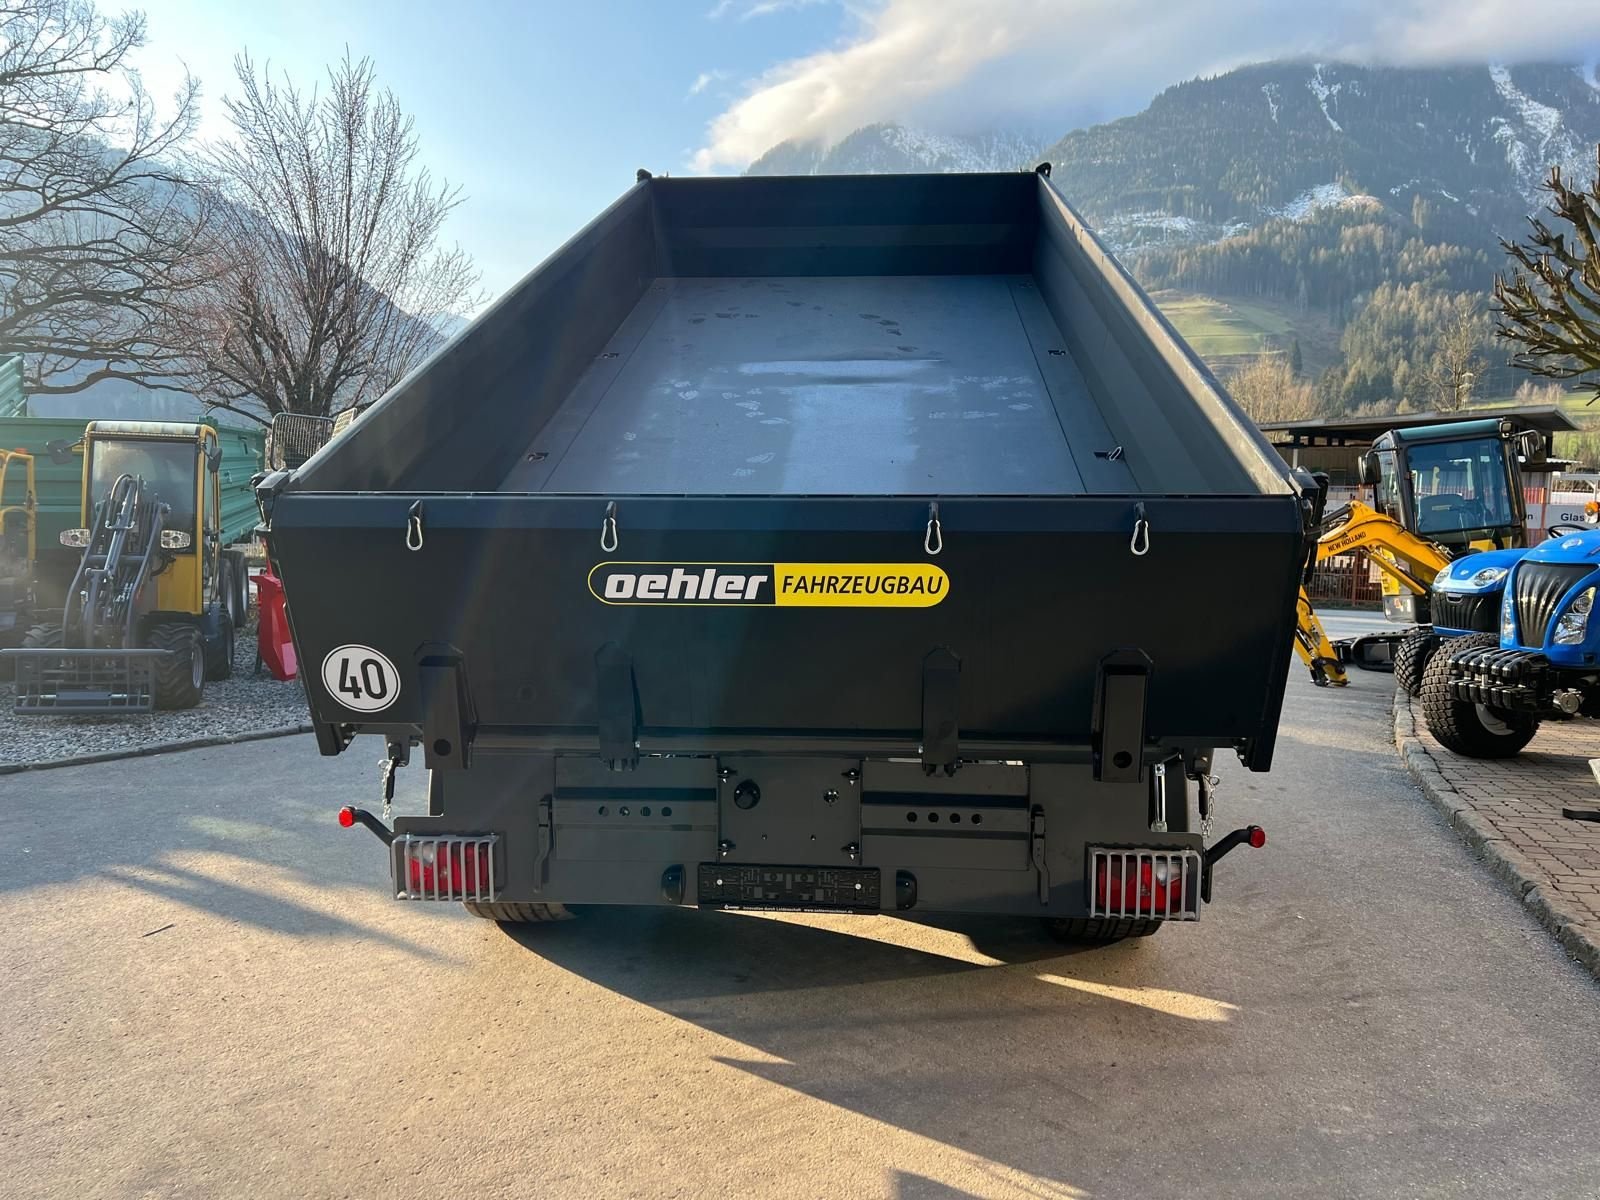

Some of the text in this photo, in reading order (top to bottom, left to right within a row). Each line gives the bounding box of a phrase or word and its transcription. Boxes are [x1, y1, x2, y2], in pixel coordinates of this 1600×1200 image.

[1327, 531, 1367, 552] NEW HOLLAND
[604, 568, 943, 600] oehler FAHRZEUGBAU
[339, 657, 388, 700] 40
